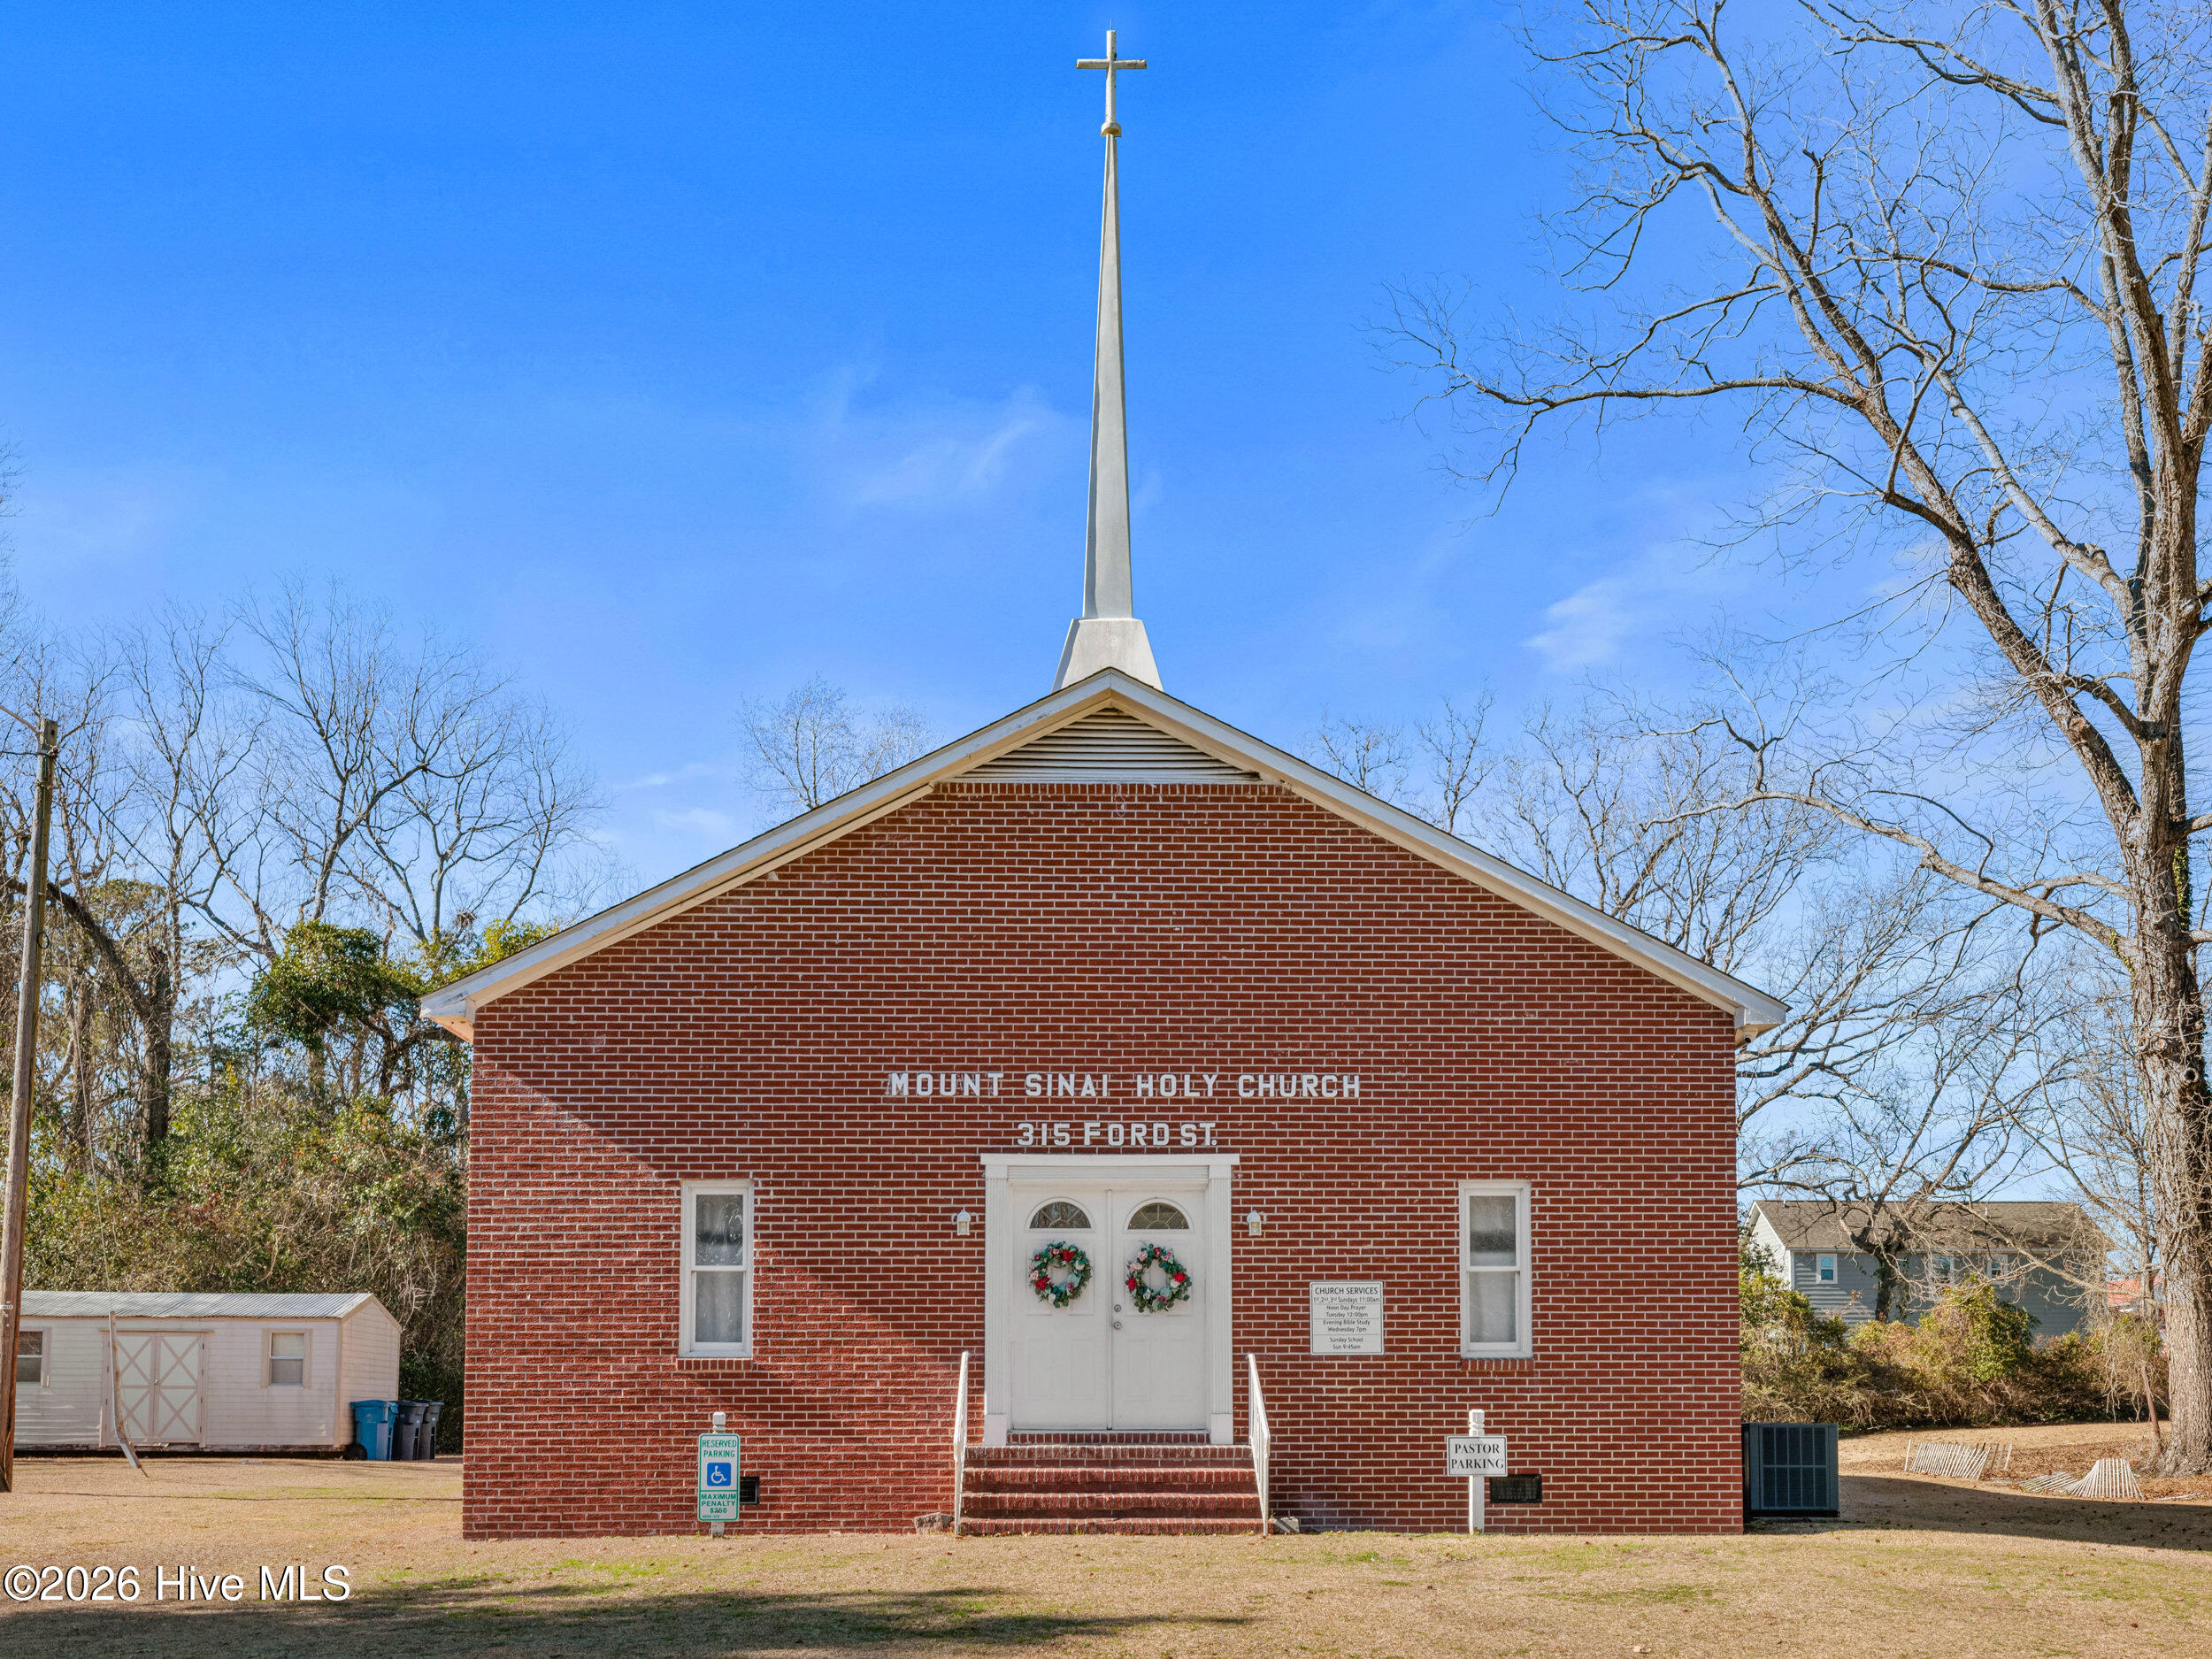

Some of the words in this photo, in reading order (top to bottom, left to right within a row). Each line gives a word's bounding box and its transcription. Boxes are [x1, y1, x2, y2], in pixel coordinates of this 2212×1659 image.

[890, 1071, 1004, 1097] MOUNT
[1025, 1073, 1109, 1097] SINAI
[1135, 1073, 1219, 1097] HOLY
[1237, 1074, 1361, 1098] CHURCH
[1018, 1122, 1071, 1147] 315
[1084, 1122, 1170, 1147] FORD
[1180, 1122, 1217, 1147] ST.
[702, 1440, 737, 1448] RESERVED
[1455, 1443, 1500, 1454] PASTOR
[703, 1449, 735, 1458] PARKING
[1451, 1458, 1504, 1469] PARKING
